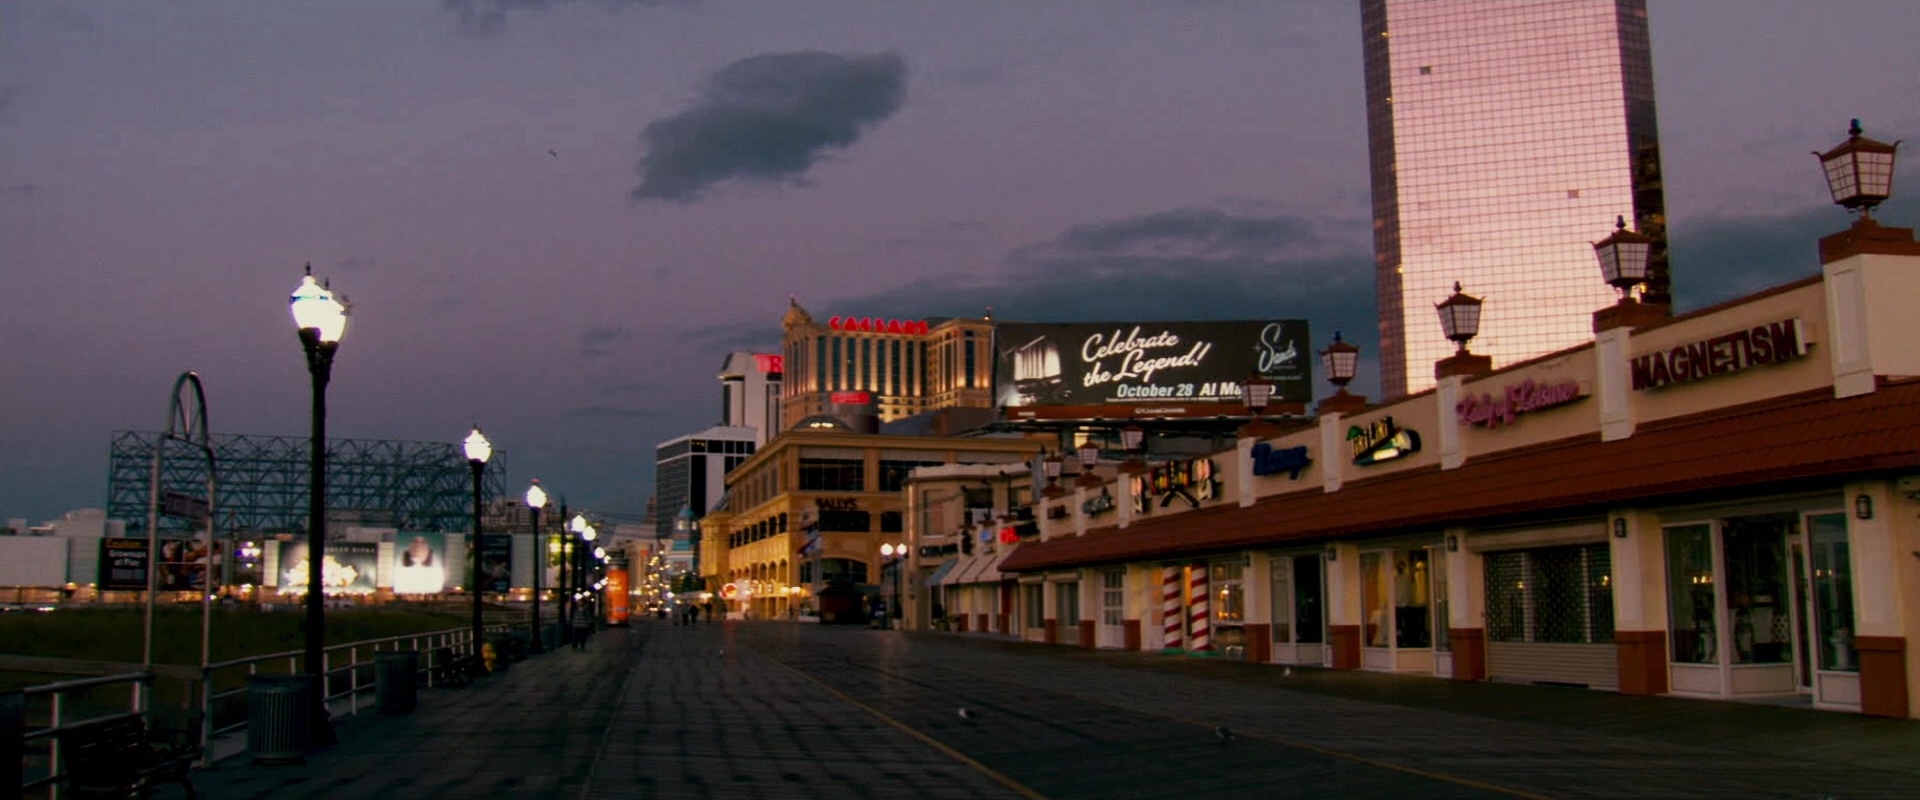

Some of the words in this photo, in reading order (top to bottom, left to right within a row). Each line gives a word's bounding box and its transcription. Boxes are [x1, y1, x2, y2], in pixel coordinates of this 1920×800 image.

[829, 315, 928, 335] CAESARS
[1081, 325, 1180, 363] Celebrate
[1630, 317, 1802, 391] MAGNETISM
[1082, 361, 1112, 388] the
[1112, 348, 1213, 383] Legend!
[1117, 383, 1175, 398] October
[1176, 383, 1195, 397] 28
[1456, 393, 1500, 429] Lady
